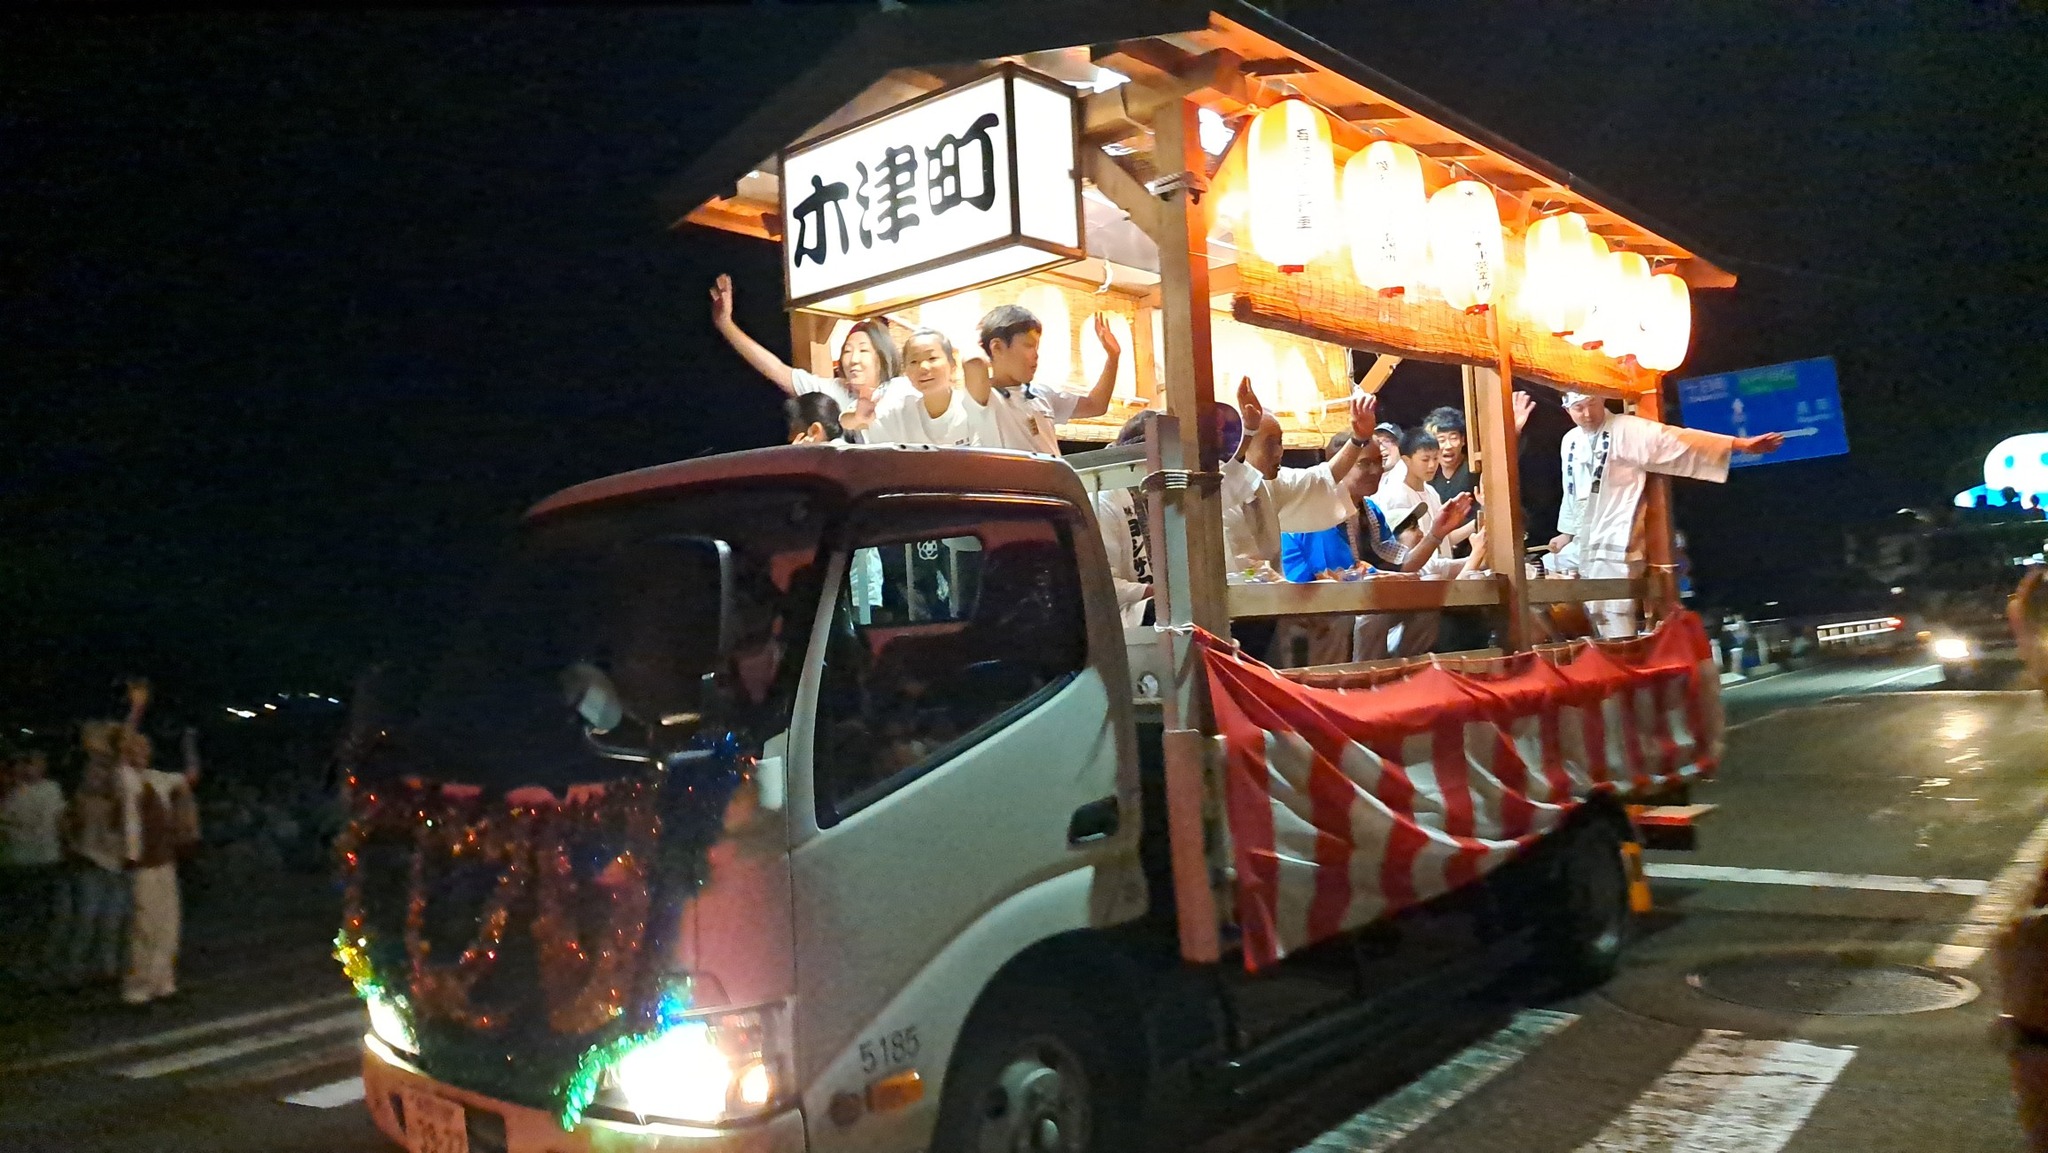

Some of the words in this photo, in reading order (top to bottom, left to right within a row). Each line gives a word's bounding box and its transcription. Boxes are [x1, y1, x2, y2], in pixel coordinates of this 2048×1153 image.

[792, 113, 1000, 268] 木津町
[859, 1025, 920, 1073] 5185
